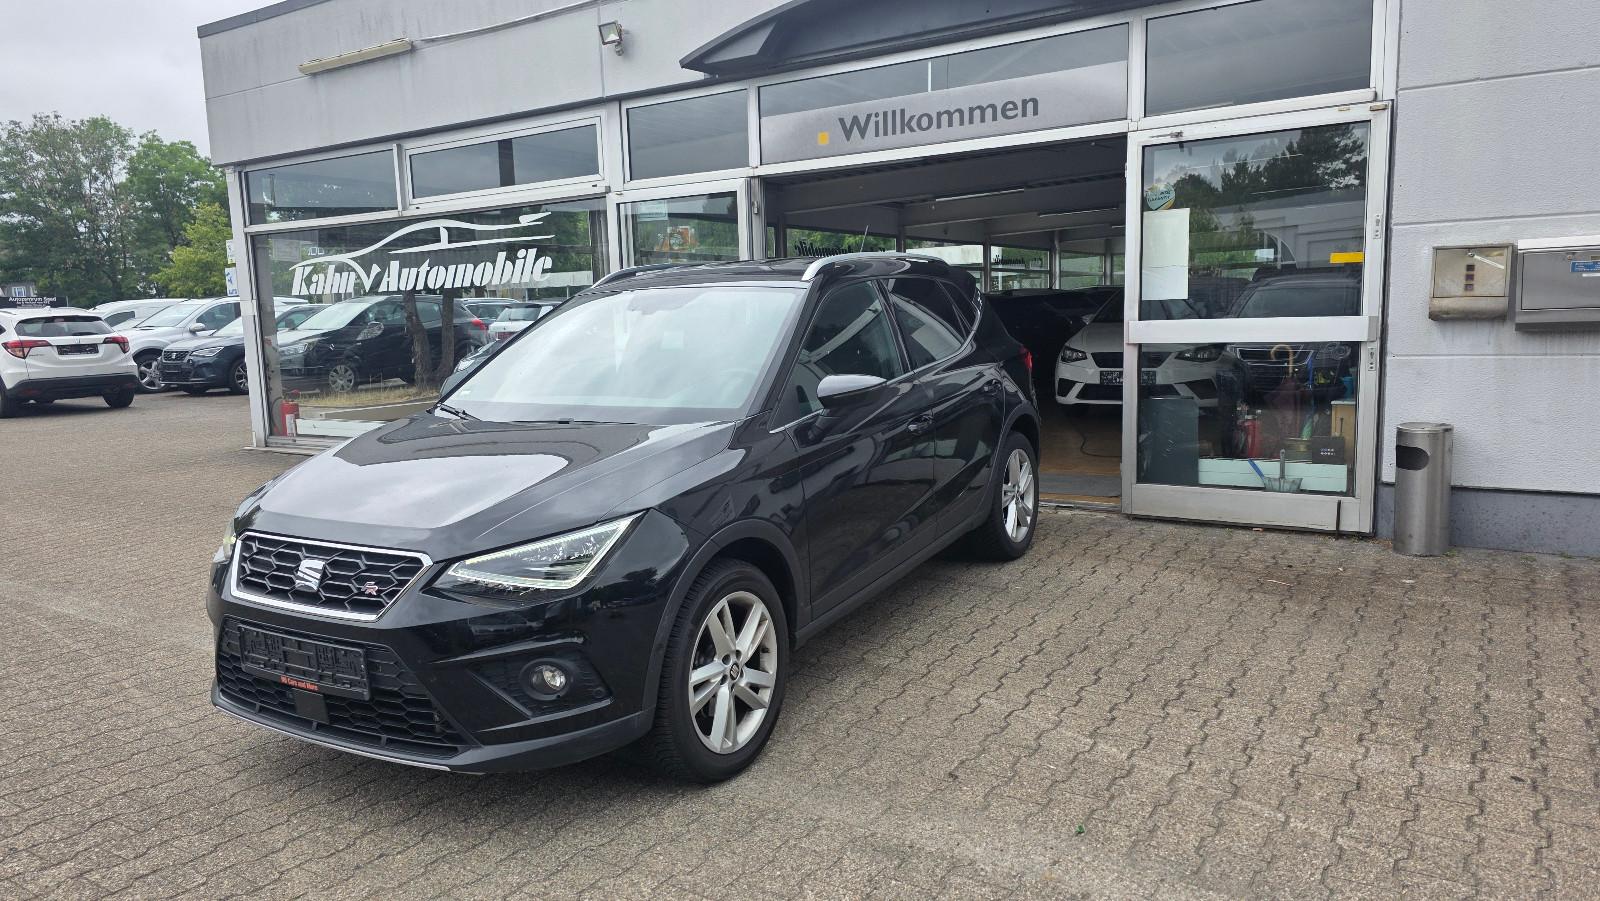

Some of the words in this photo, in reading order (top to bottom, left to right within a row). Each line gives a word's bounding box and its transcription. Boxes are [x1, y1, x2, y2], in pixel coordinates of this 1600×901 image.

[838, 97, 1039, 142] Willkommen
[291, 264, 356, 296] Kahn
[377, 248, 553, 293] Automobile
